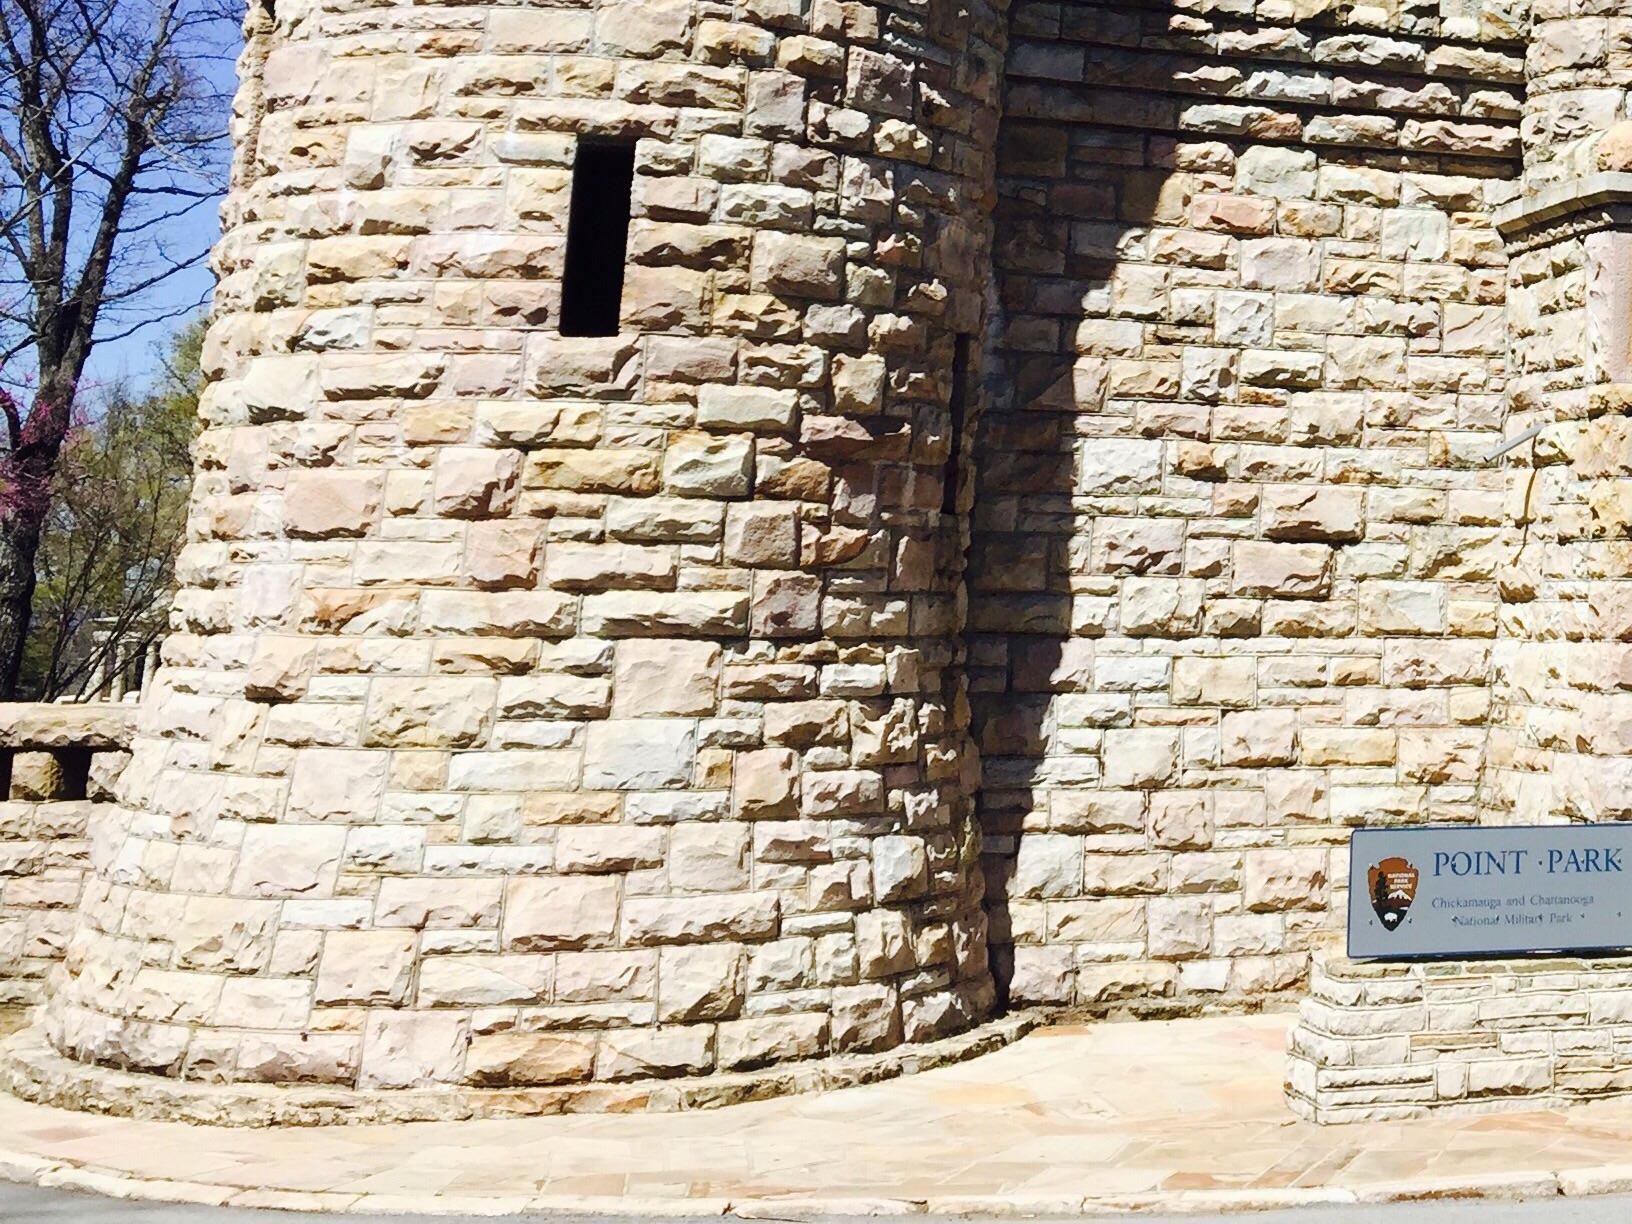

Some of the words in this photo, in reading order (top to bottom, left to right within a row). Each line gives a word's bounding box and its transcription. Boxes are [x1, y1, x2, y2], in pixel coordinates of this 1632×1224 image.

[1433, 850, 1528, 877] POINT
[1546, 848, 1623, 874] PARK
[1431, 896, 1501, 909] Chickamauga
[1505, 895, 1525, 907] and
[1529, 894, 1594, 907] Chattanooga
[1454, 915, 1499, 927] National
[1504, 913, 1543, 926] Military
[1549, 912, 1573, 923] Park
